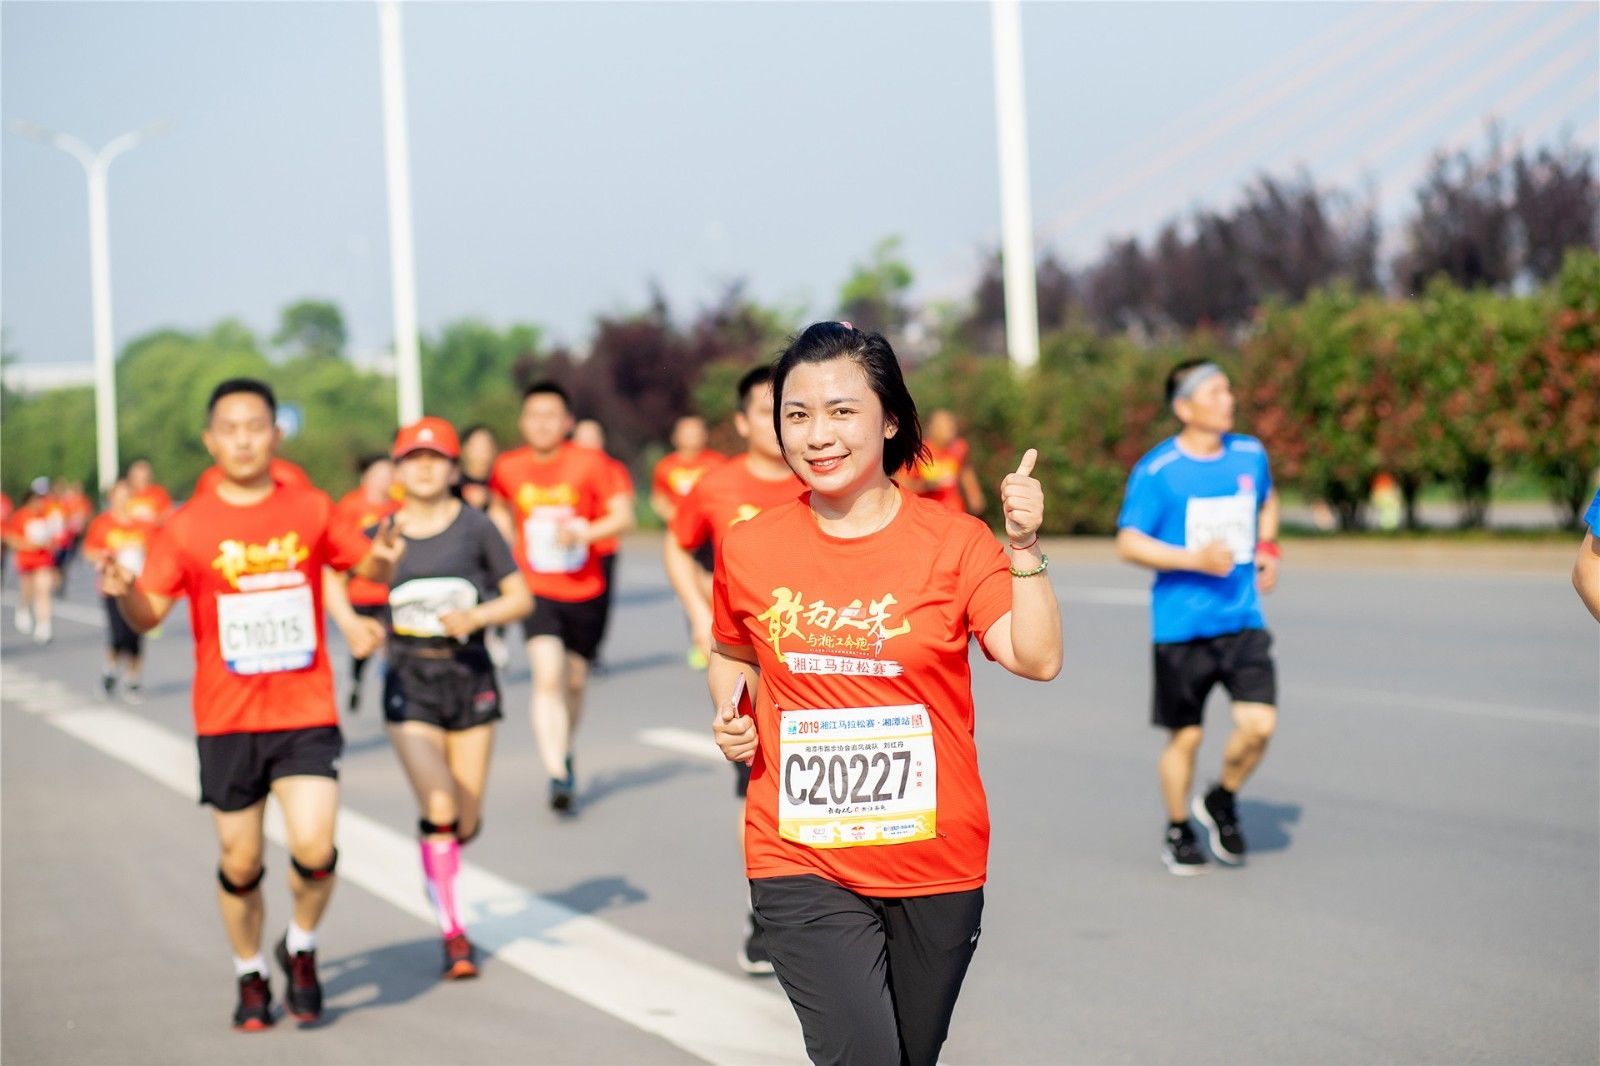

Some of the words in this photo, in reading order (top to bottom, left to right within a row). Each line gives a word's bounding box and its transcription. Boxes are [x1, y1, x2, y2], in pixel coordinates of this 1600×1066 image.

[793, 657, 887, 676] 湘江马拉松赛
[785, 750, 911, 806] C20227
